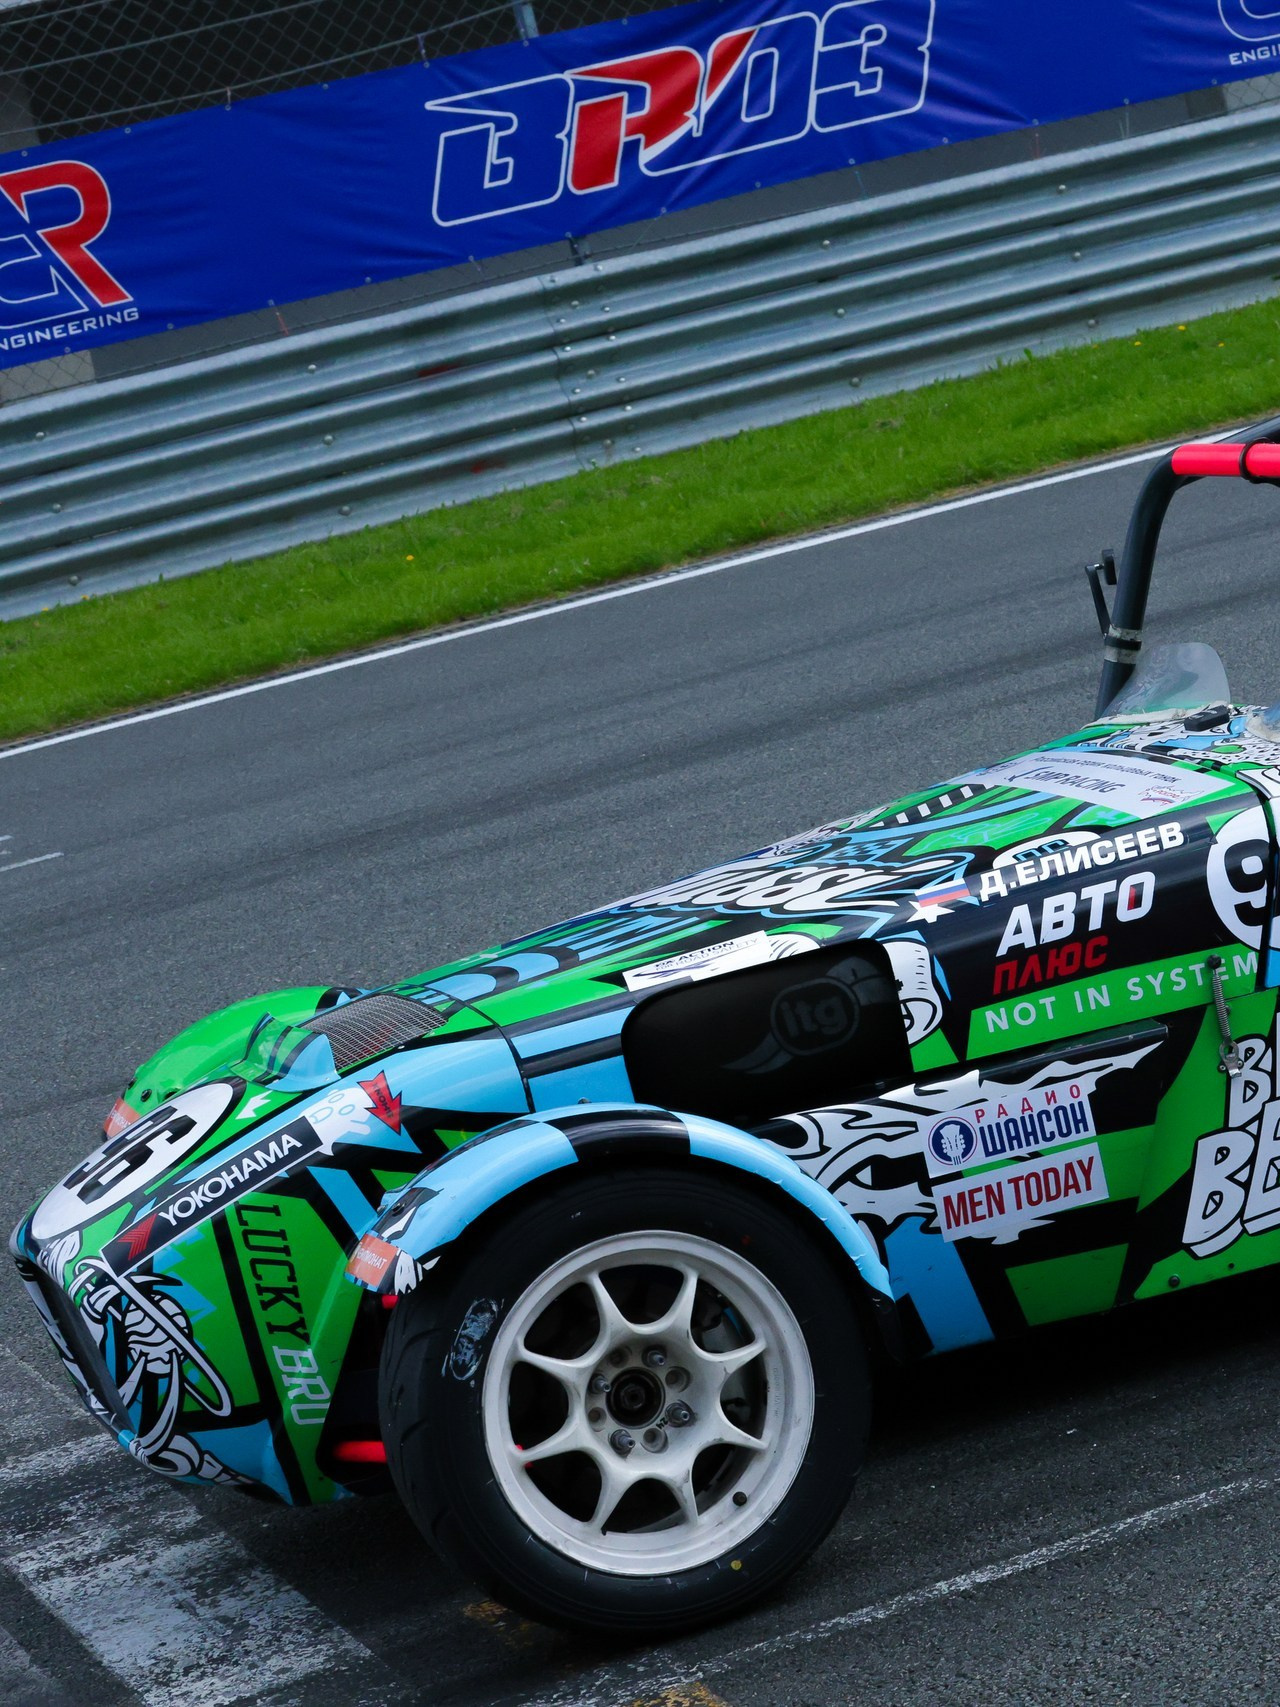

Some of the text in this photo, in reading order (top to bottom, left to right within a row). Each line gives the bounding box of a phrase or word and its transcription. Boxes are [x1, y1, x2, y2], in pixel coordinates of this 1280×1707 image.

[1061, 775, 1127, 794] RACING
[978, 821, 1186, 902] Д.ЕЛИСЕЕВ
[677, 941, 735, 960] ACTION
[995, 871, 1156, 958] АВТО
[984, 951, 1260, 1033] NOT IN SYSTEM
[992, 935, 1109, 996] ПЛЮС
[974, 1084, 1081, 1124] РАДИО
[978, 1100, 1090, 1158] ШАНСОН
[158, 1133, 303, 1227] YOKOHAMA
[943, 1155, 1095, 1230] MEN TODAY
[234, 1200, 312, 1345] LUCKY
